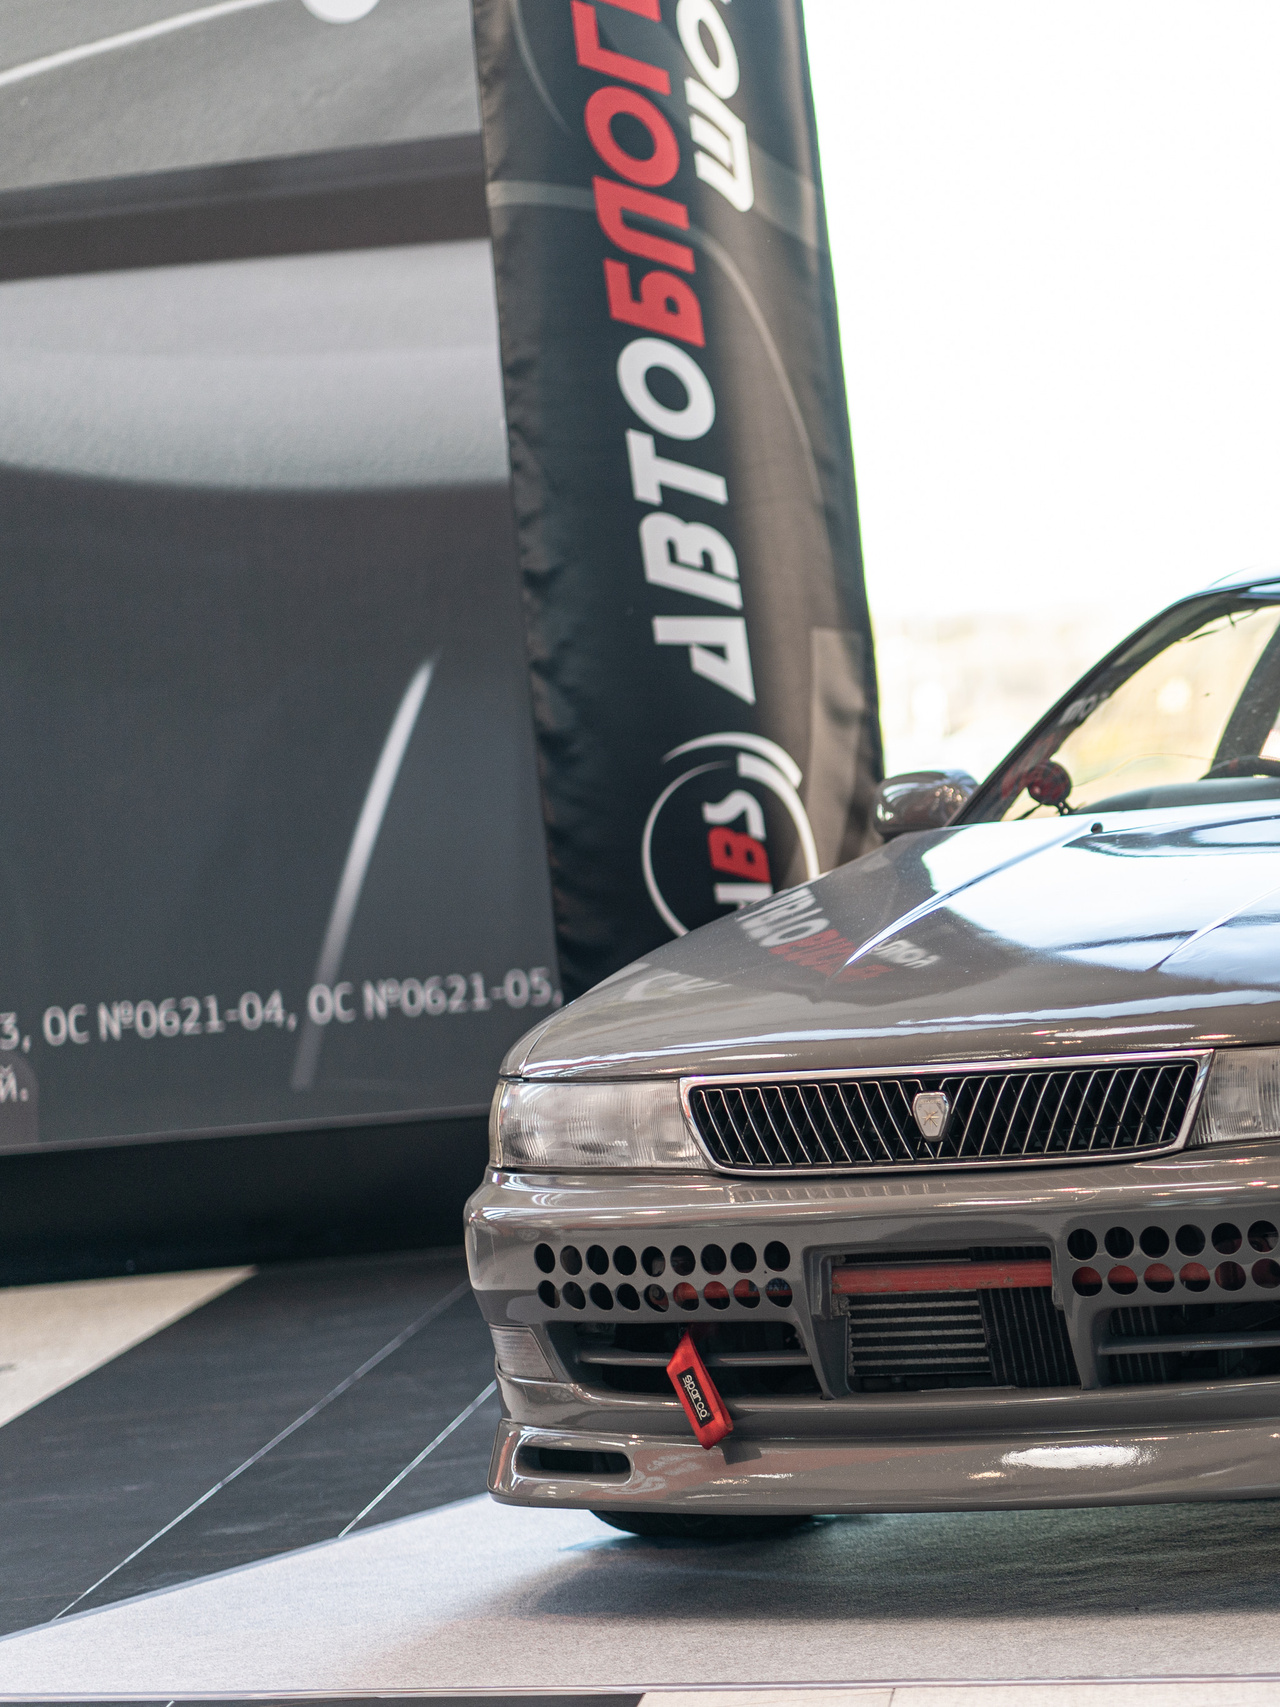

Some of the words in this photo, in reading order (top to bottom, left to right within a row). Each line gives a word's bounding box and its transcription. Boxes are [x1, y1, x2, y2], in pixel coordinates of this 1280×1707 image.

[676, 0, 755, 212] ШО
[571, 0, 756, 705] АВТОБЛОГ
[683, 1374, 708, 1419] sparco
